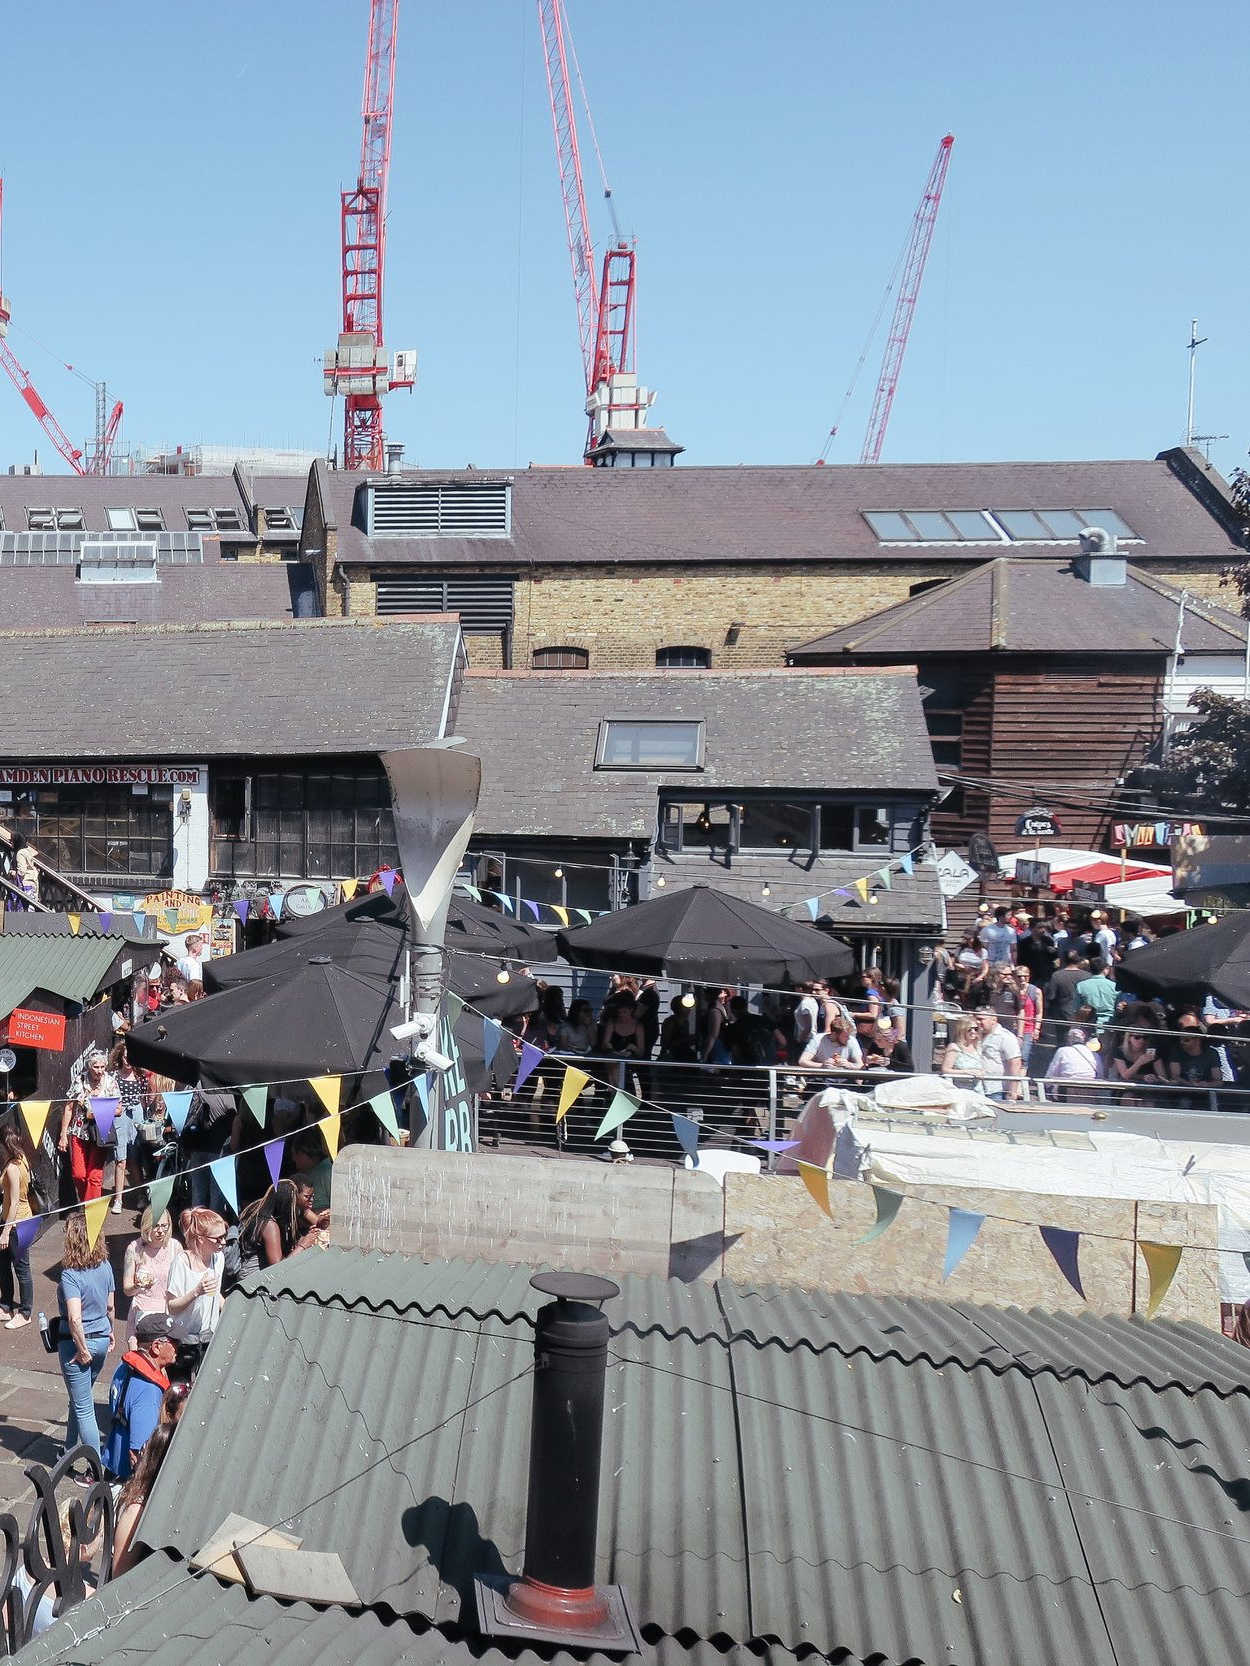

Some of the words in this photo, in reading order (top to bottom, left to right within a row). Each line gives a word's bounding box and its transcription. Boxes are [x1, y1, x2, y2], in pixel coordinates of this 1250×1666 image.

[52, 768, 105, 784] PIANO
[107, 768, 199, 784] RESCUE.COM
[146, 891, 202, 906] PAINTING
[164, 900, 182, 908] AND
[17, 1013, 60, 1026] INDONESIAN
[16, 1021, 39, 1031] STREET
[15, 1030, 45, 1041] KITCHEN
